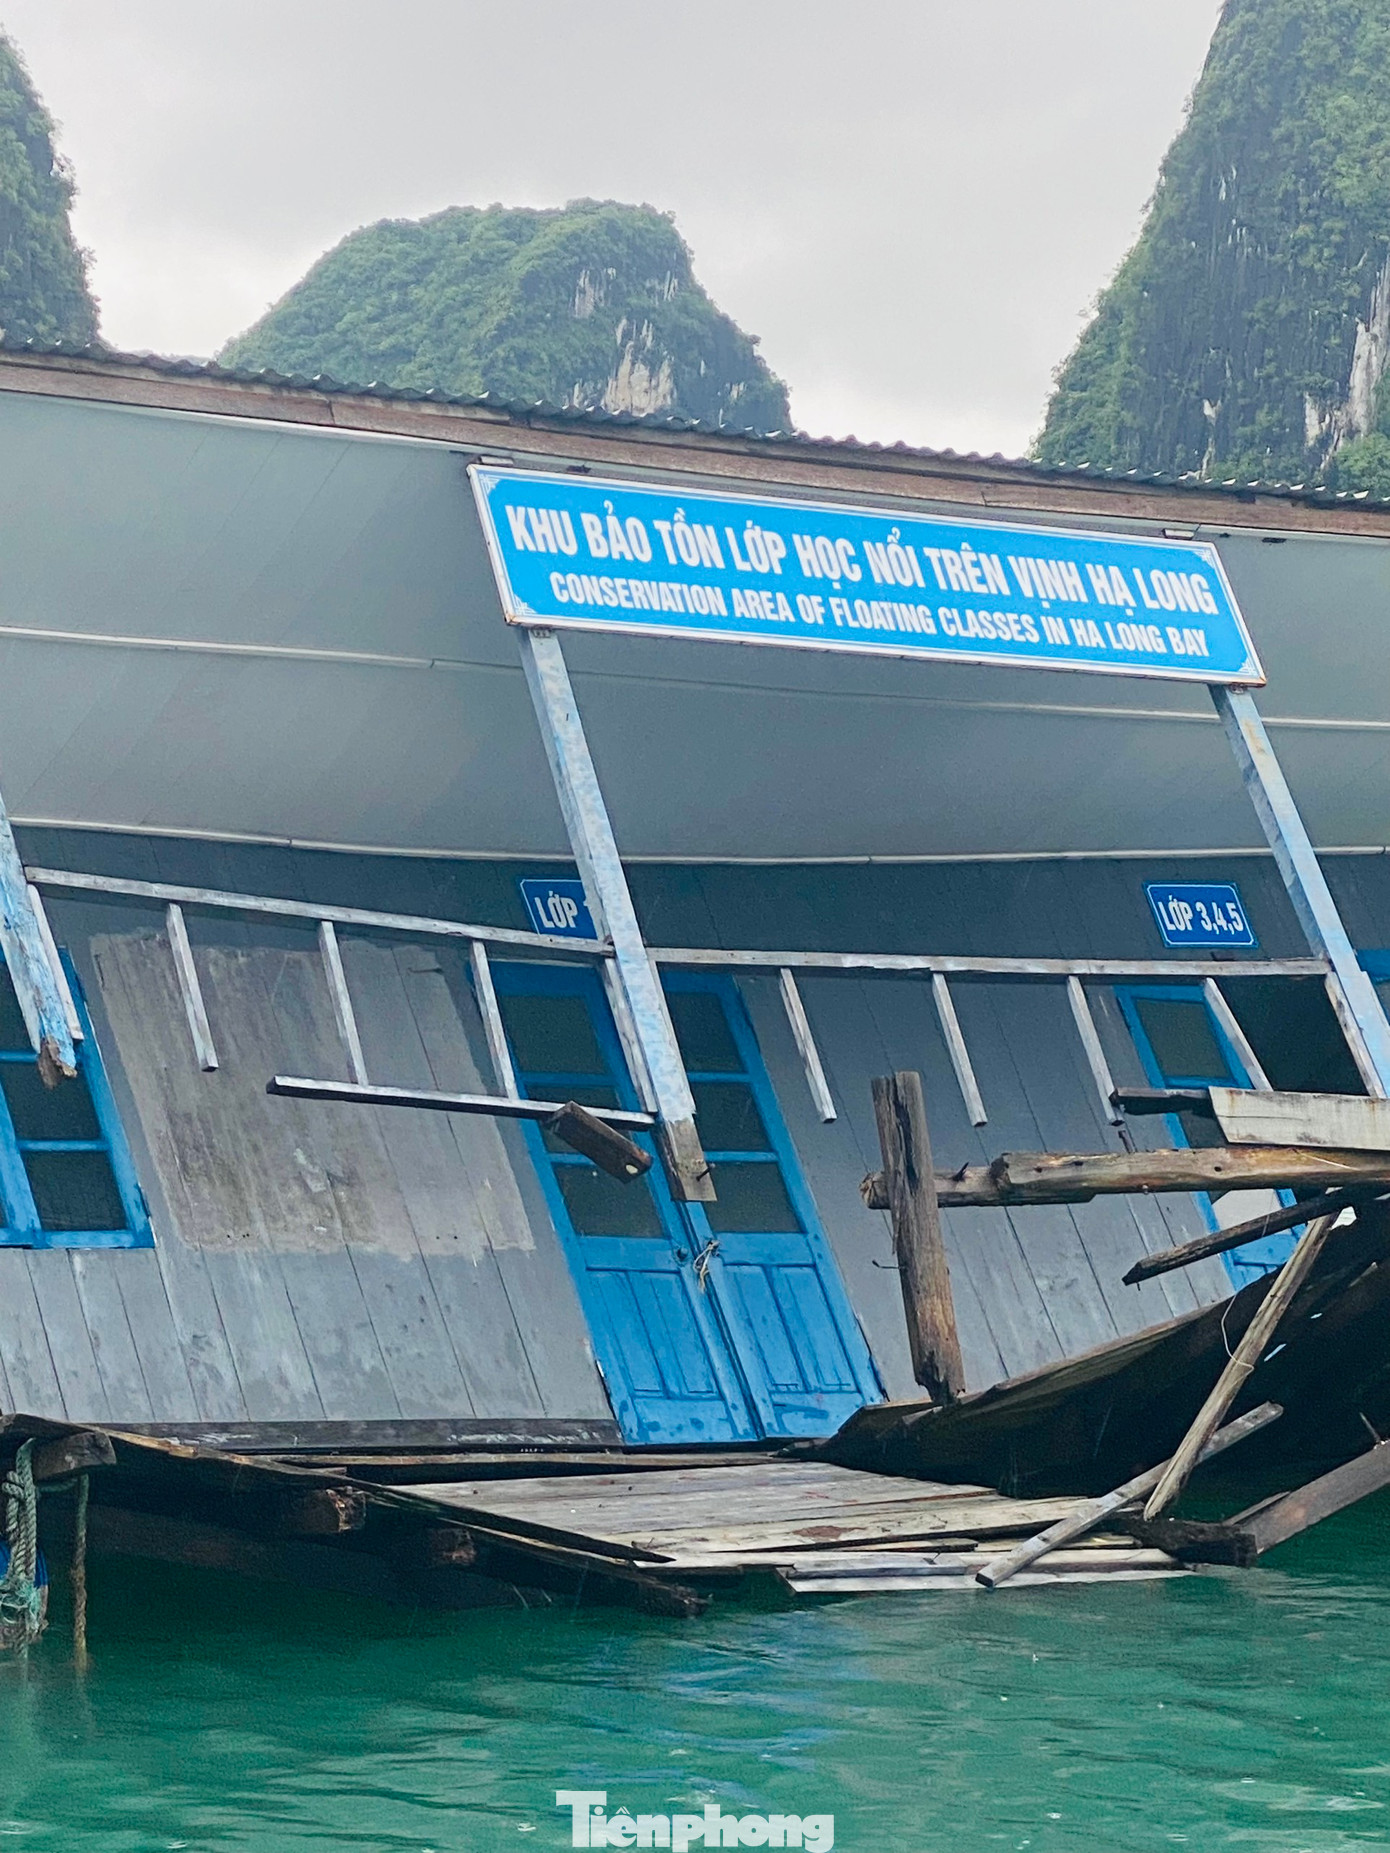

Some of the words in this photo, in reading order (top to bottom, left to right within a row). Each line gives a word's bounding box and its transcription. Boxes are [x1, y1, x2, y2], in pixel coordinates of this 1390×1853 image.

[505, 504, 578, 555] KHU
[580, 500, 652, 563] BẢO
[653, 507, 725, 569] TỒN
[724, 520, 786, 575] LỚP
[792, 533, 861, 589] HỌC
[863, 527, 926, 588] NỔI
[923, 541, 1009, 596] TRÊN
[1007, 555, 1088, 608] VỊNH
[1085, 563, 1136, 616] HẠ
[1132, 567, 1219, 615] LONG
[549, 571, 728, 616] CONSERVATION
[731, 587, 795, 623] AREA
[796, 593, 825, 625] OF
[828, 596, 937, 635] FLOATING
[937, 606, 1039, 644] CLASSES
[1041, 616, 1070, 645] IN
[1069, 618, 1105, 648] HA
[1104, 620, 1167, 653] LONG
[1165, 626, 1209, 657] BAY
[534, 890, 578, 928] LỚP
[1157, 895, 1193, 931] LỚP
[1195, 902, 1244, 935] 3,4,5
